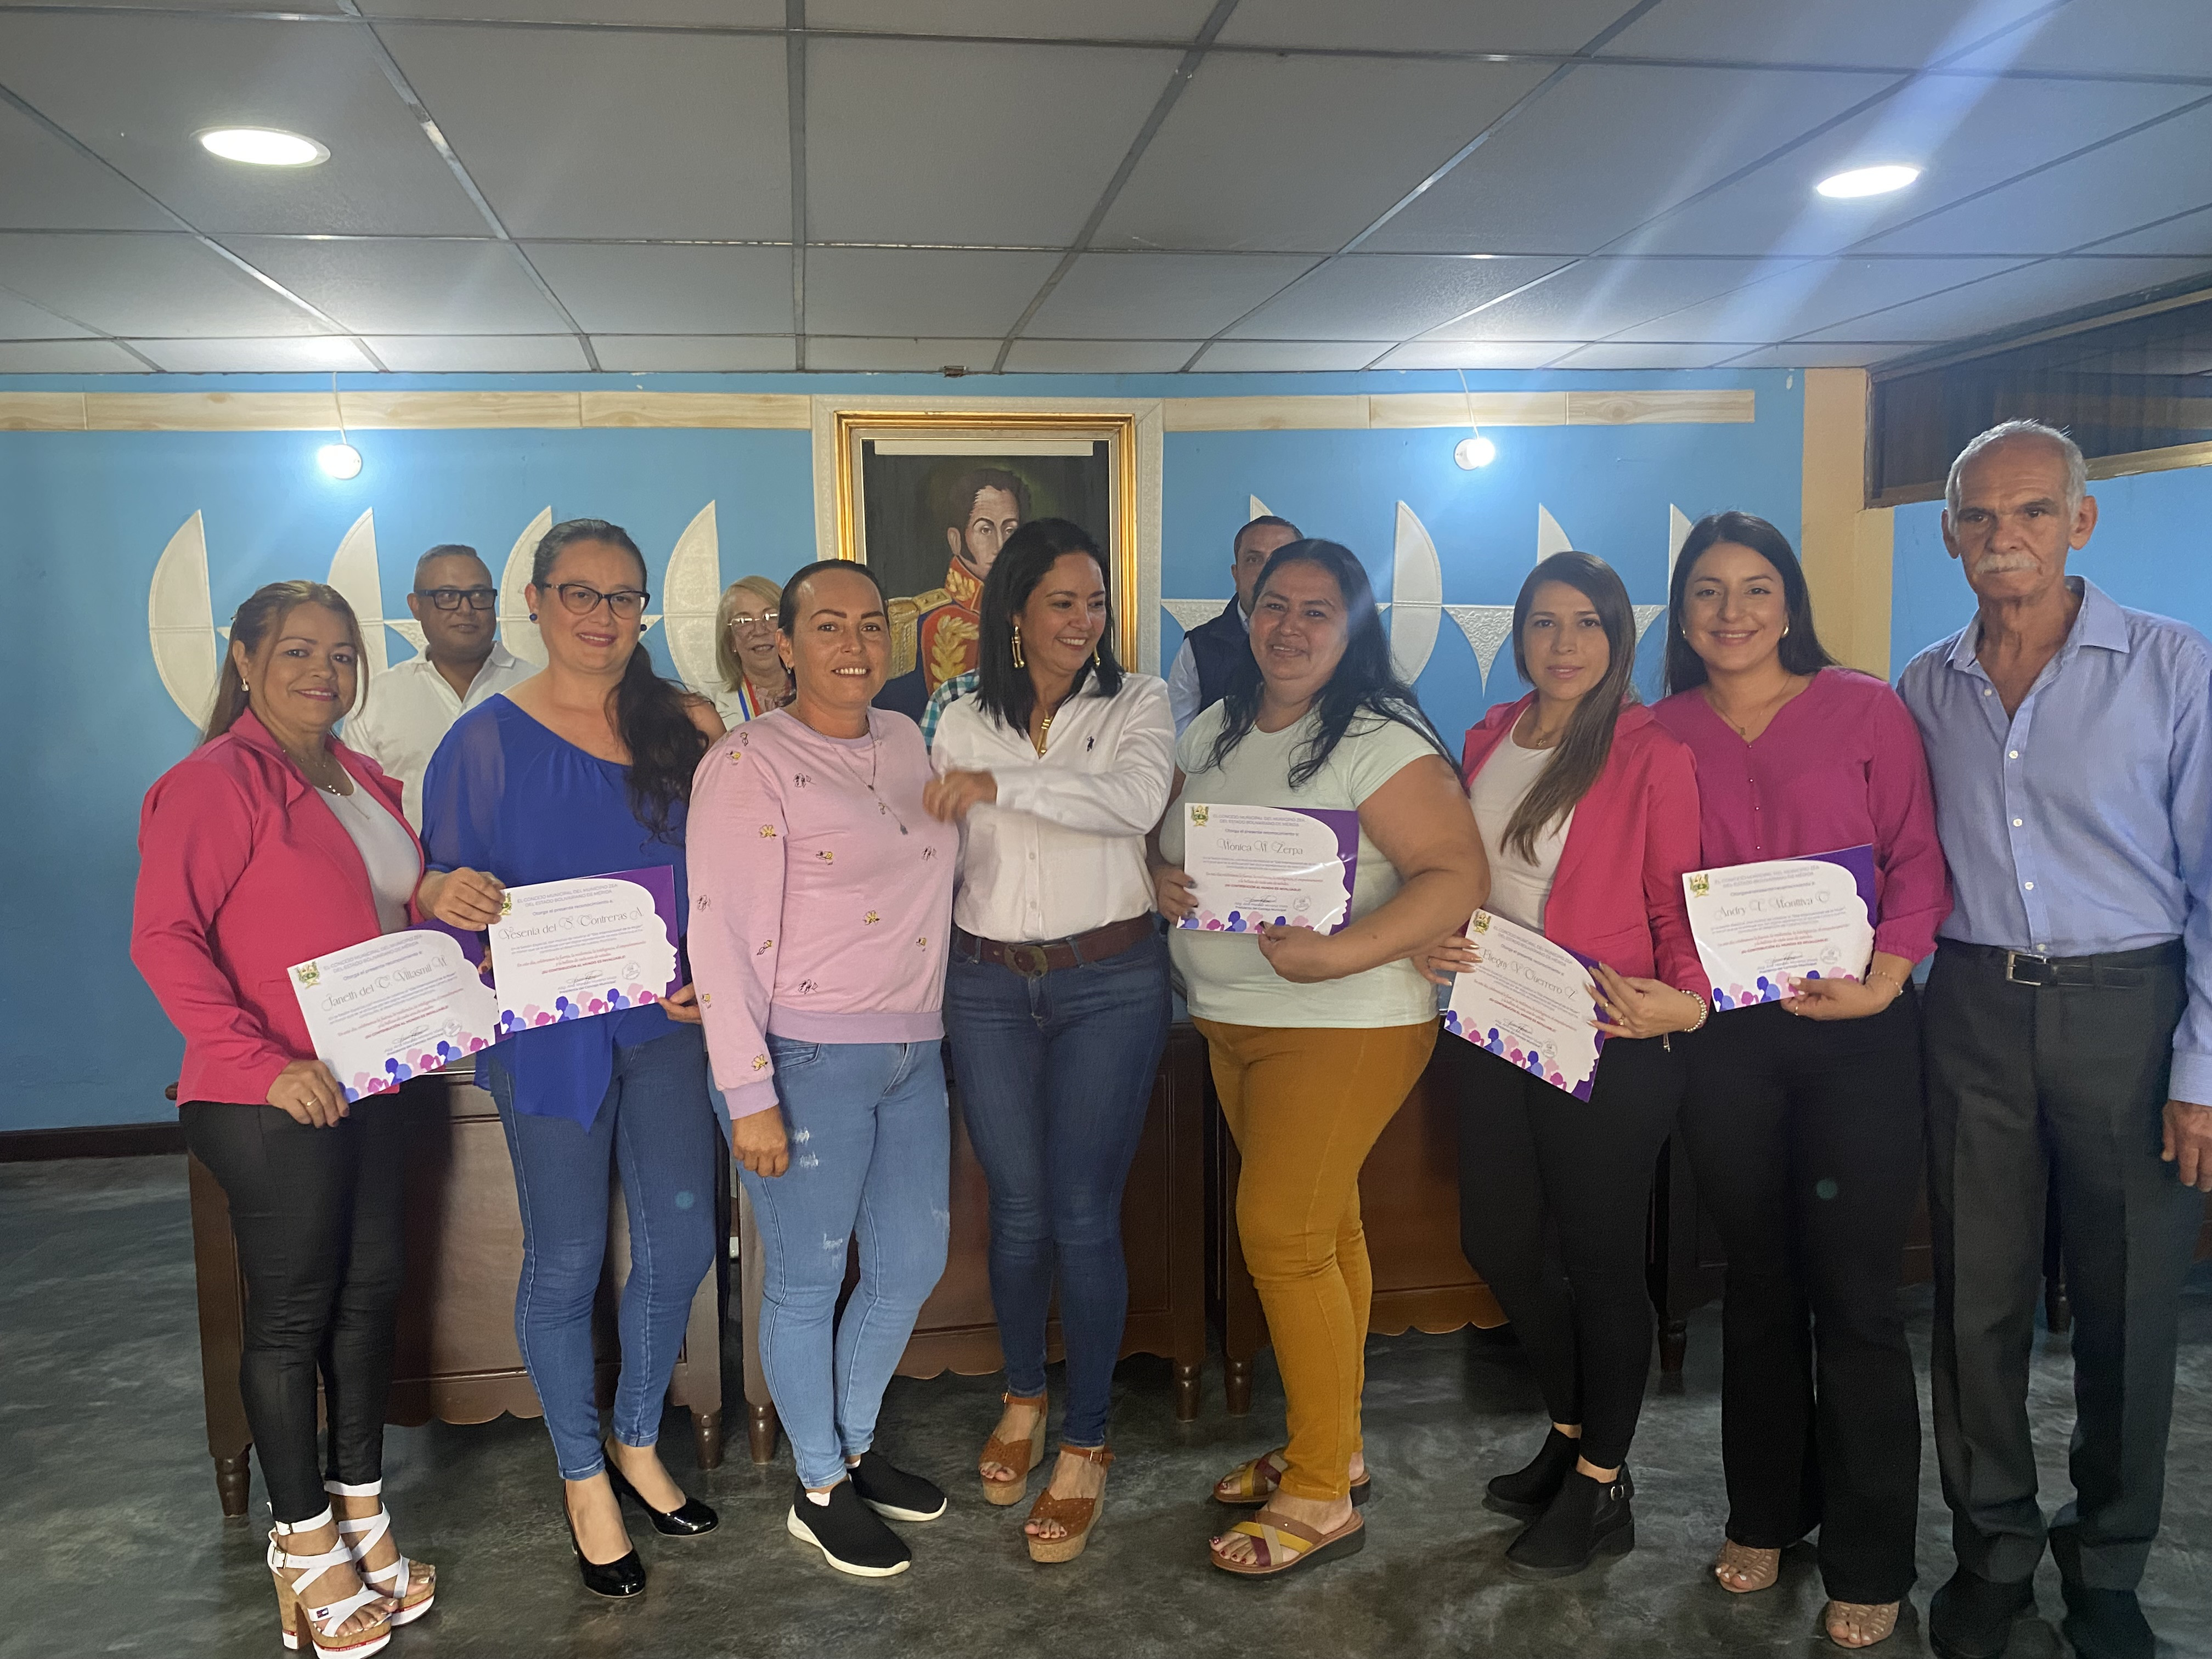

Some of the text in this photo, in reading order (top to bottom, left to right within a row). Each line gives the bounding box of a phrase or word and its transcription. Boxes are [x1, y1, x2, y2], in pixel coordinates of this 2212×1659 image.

[1217, 838, 1251, 851] Mónica
[1271, 841, 1303, 855] Zerpa
[523, 894, 546, 902] CONCEJO
[546, 890, 572, 899] MUNICIPAL
[583, 884, 608, 893] MUNICIPIO
[555, 893, 586, 902] BOLIVARIANO
[498, 927, 540, 939] Yesenia
[543, 923, 556, 934] del
[577, 913, 627, 927] Contreras
[321, 991, 357, 1011] Janeth
[359, 984, 374, 996] del
[393, 963, 432, 981] Villasmil
